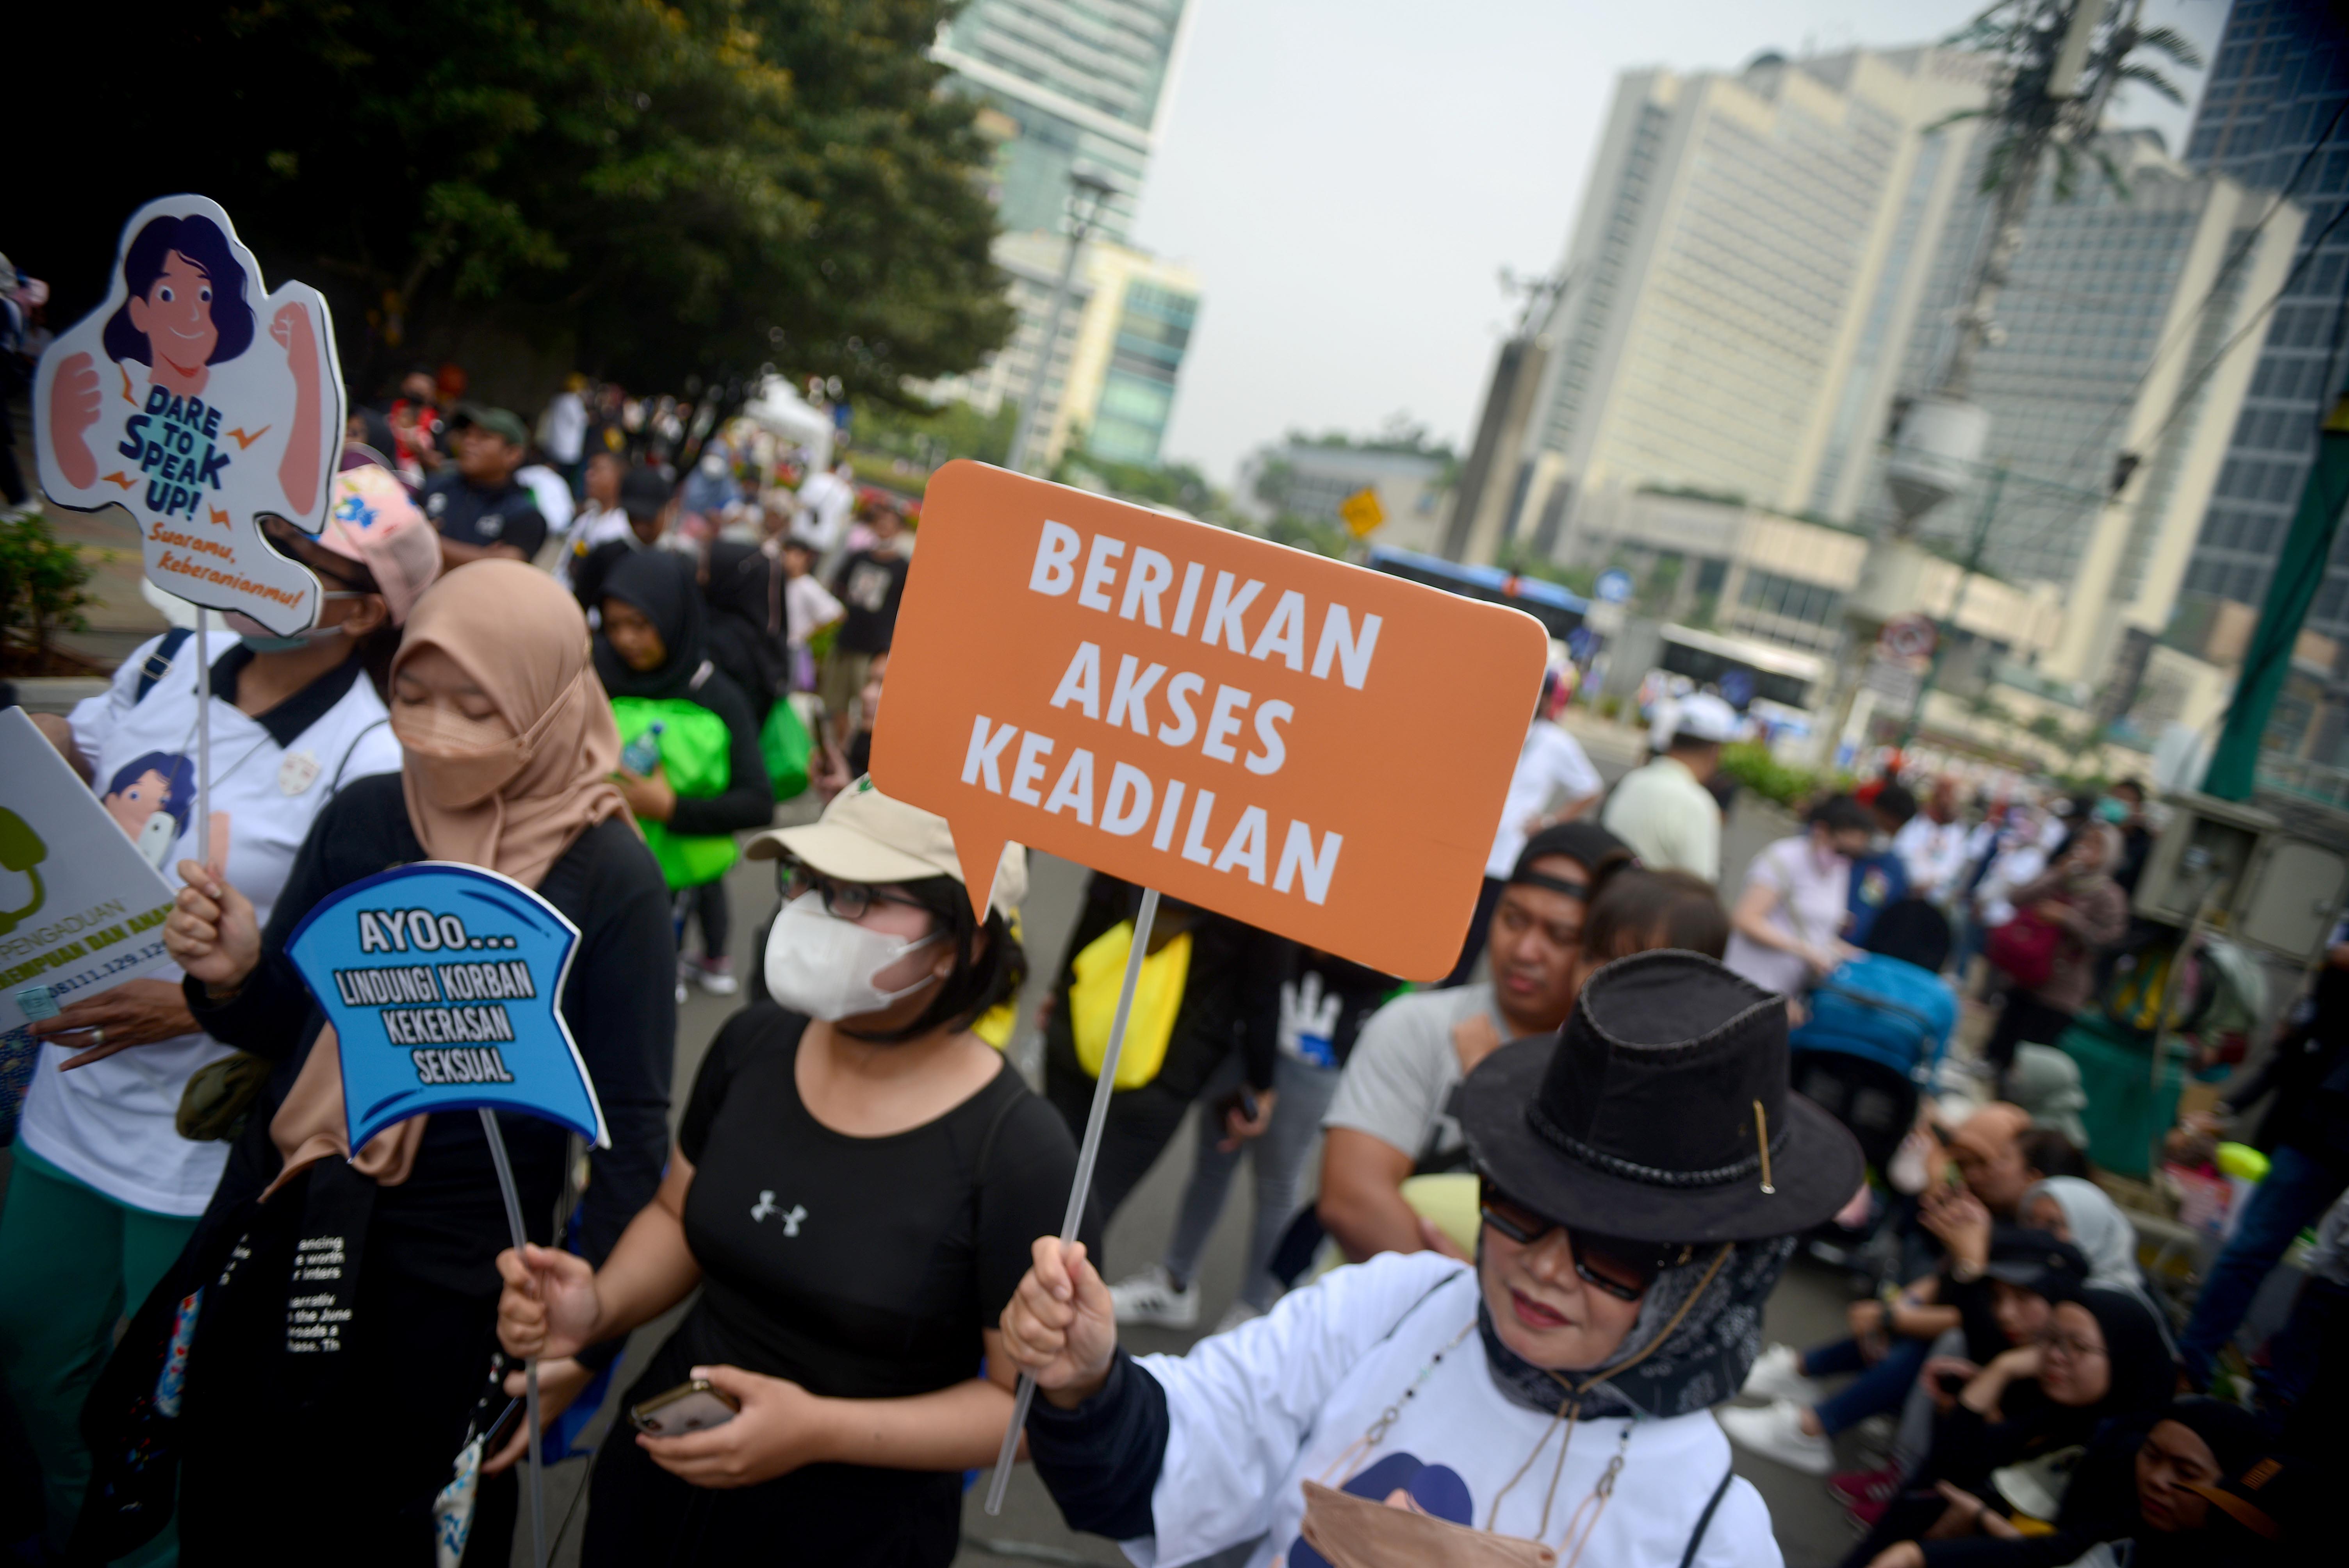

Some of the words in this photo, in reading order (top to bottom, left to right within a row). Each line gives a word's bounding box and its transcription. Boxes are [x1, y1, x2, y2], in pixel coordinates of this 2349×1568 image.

[145, 384, 222, 440] DARE
[118, 414, 231, 490] SPEAK
[163, 421, 193, 454] TO
[146, 480, 203, 521] UP!
[148, 522, 236, 564] Suaramu,
[1028, 519, 1383, 691] BERIKAN
[1049, 640, 1295, 775] AKSES
[960, 714, 1344, 906] KEADILAN
[83, 924, 130, 951] DAN
[333, 965, 442, 1006] LINDUNGI
[436, 959, 536, 1001] KORBAN
[380, 1004, 515, 1044] KEKERASAN
[411, 1046, 514, 1084] SEKSUAL
